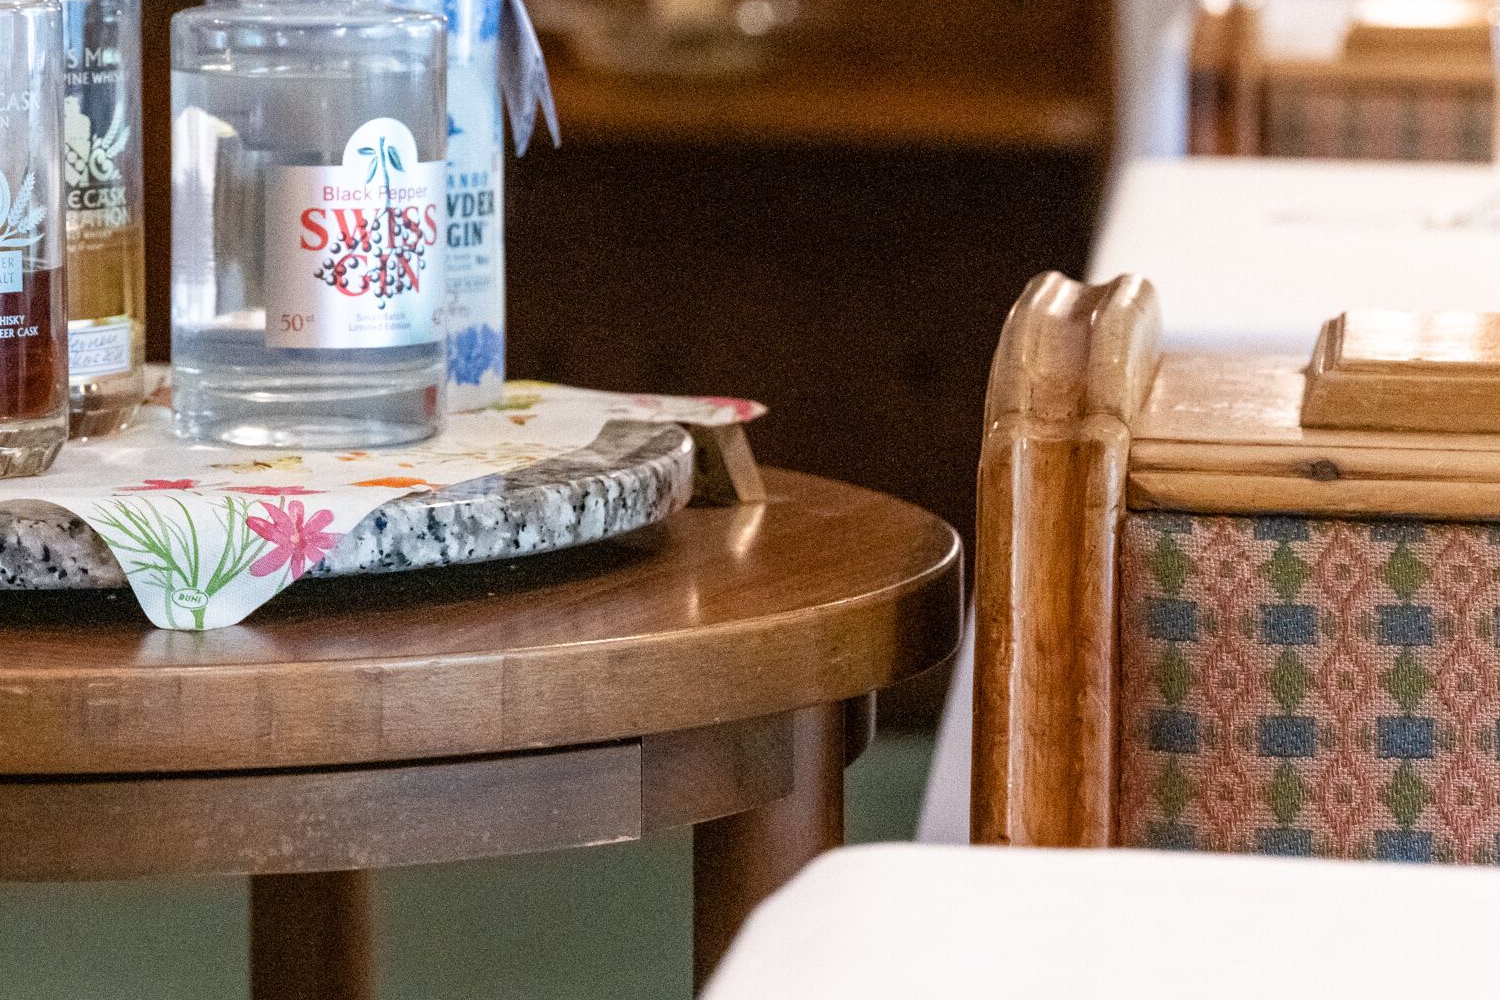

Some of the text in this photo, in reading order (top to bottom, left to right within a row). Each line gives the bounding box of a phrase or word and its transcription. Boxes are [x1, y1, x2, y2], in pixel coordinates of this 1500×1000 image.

[324, 186, 428, 202] Black Pepper
[300, 203, 438, 252] SWISS
[446, 221, 482, 248] GIN
[330, 254, 421, 297] GIN
[17, 324, 40, 337] CASK
[179, 594, 201, 603] DUNI
